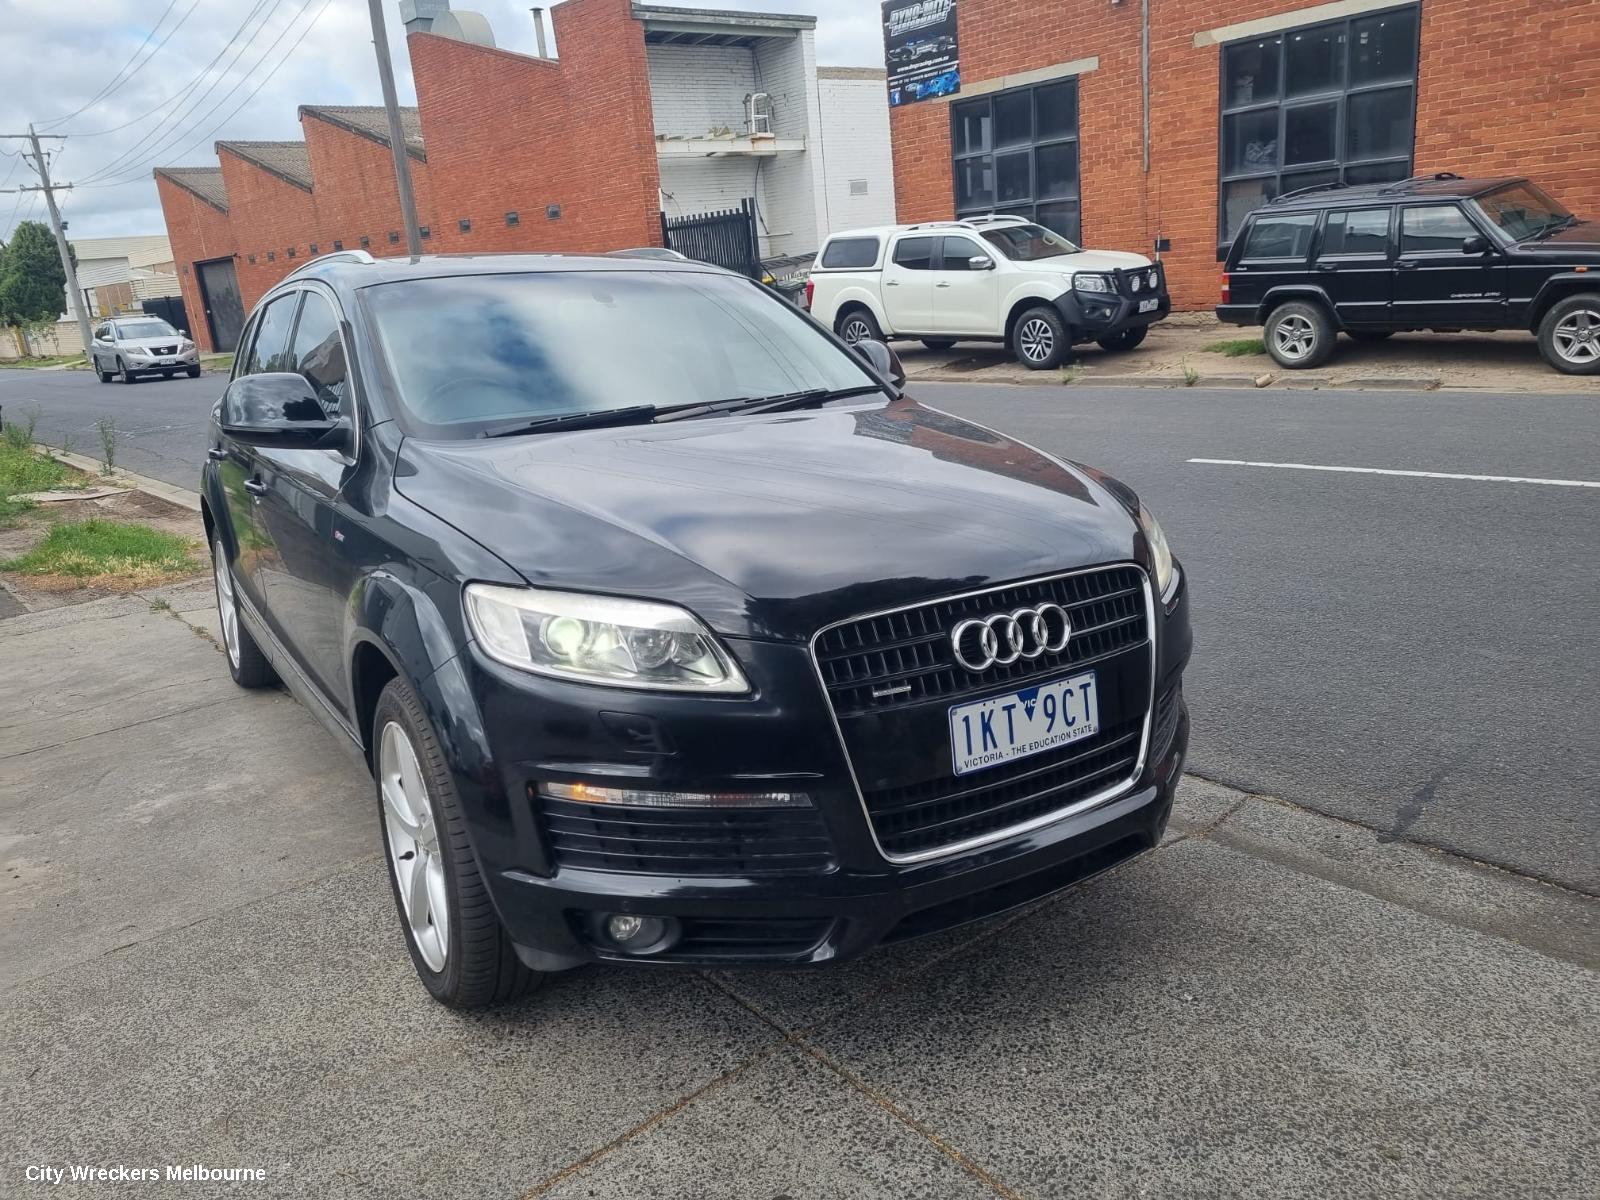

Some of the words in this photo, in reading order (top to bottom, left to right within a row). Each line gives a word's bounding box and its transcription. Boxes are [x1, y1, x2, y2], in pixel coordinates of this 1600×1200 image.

[890, 0, 950, 26] DYNO-MITE
[892, 11, 947, 33] PERFORMANCE
[964, 752, 1004, 769] VICTORIA
[1011, 744, 1027, 756] THE
[1029, 731, 1071, 751] EDUCATION
[1072, 723, 1092, 739] STATE
